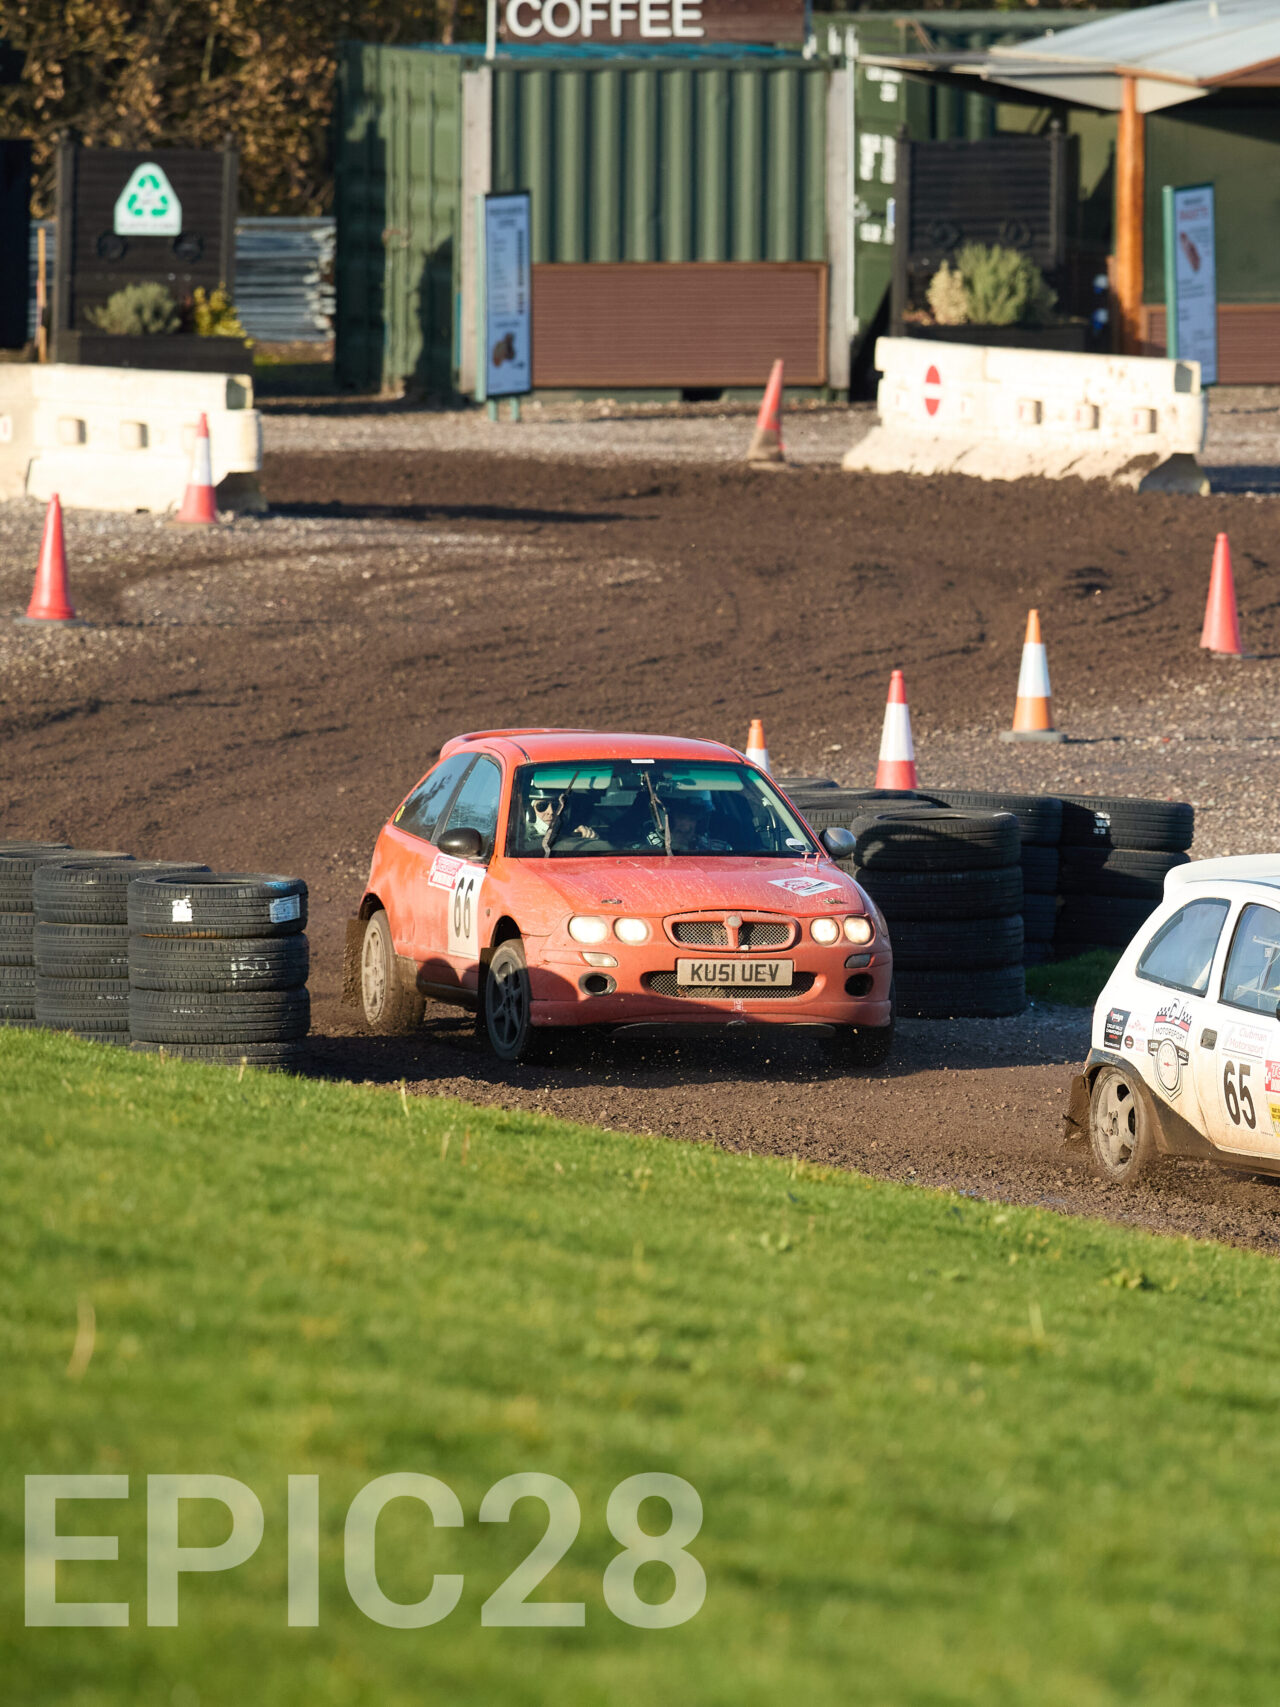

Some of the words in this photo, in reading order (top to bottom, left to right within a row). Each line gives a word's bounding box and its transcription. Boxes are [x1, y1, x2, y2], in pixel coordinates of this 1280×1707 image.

[506, 0, 704, 37] COFFEE
[454, 877, 474, 938] 66
[690, 963, 736, 983] KU51
[741, 963, 780, 983] UEV
[1155, 1026, 1186, 1043] MOTORSPORT
[1239, 1027, 1268, 1042] Clubman
[1230, 1037, 1265, 1055] Motorsport
[1223, 1060, 1257, 1130] 65
